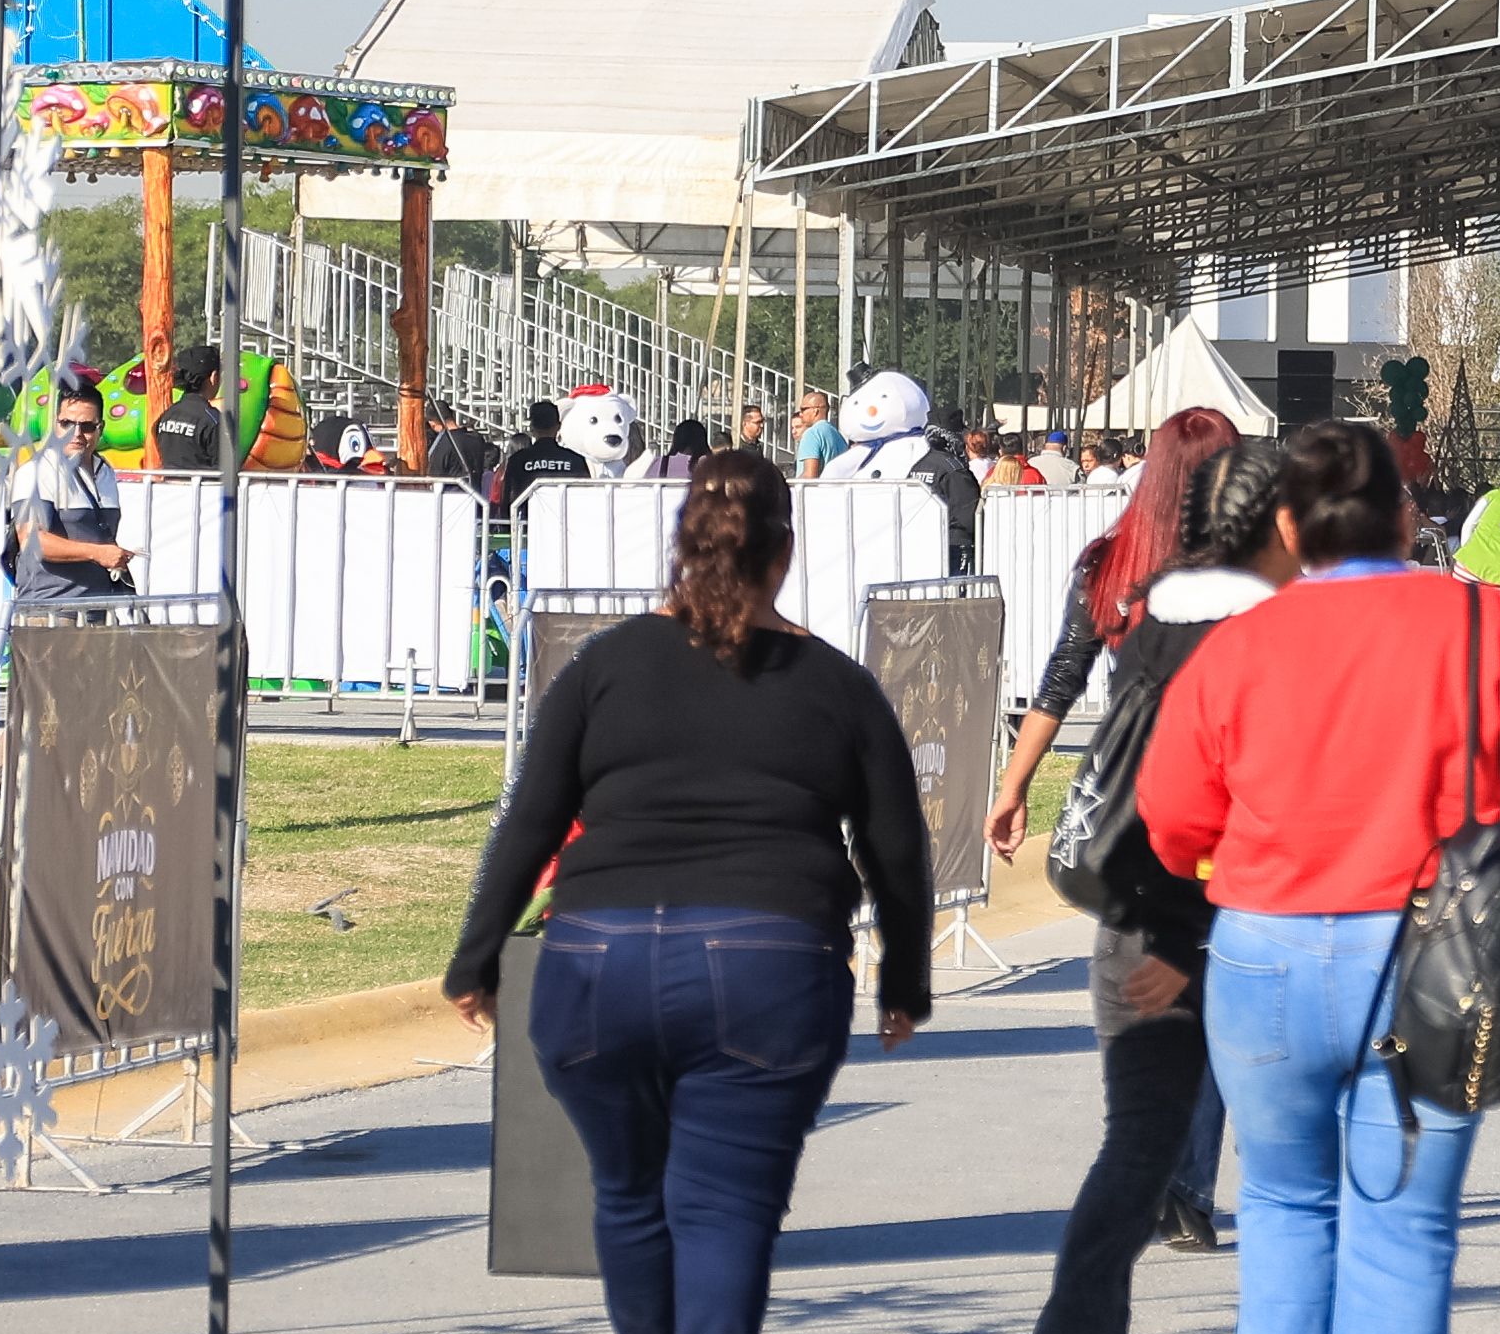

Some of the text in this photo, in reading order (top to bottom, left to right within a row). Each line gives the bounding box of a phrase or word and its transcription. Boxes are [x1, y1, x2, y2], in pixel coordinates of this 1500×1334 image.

[524, 459, 571, 471] CADETE
[96, 829, 156, 884] NAVIDAD
[114, 876, 135, 901] CON
[91, 903, 157, 984] Fuerza
